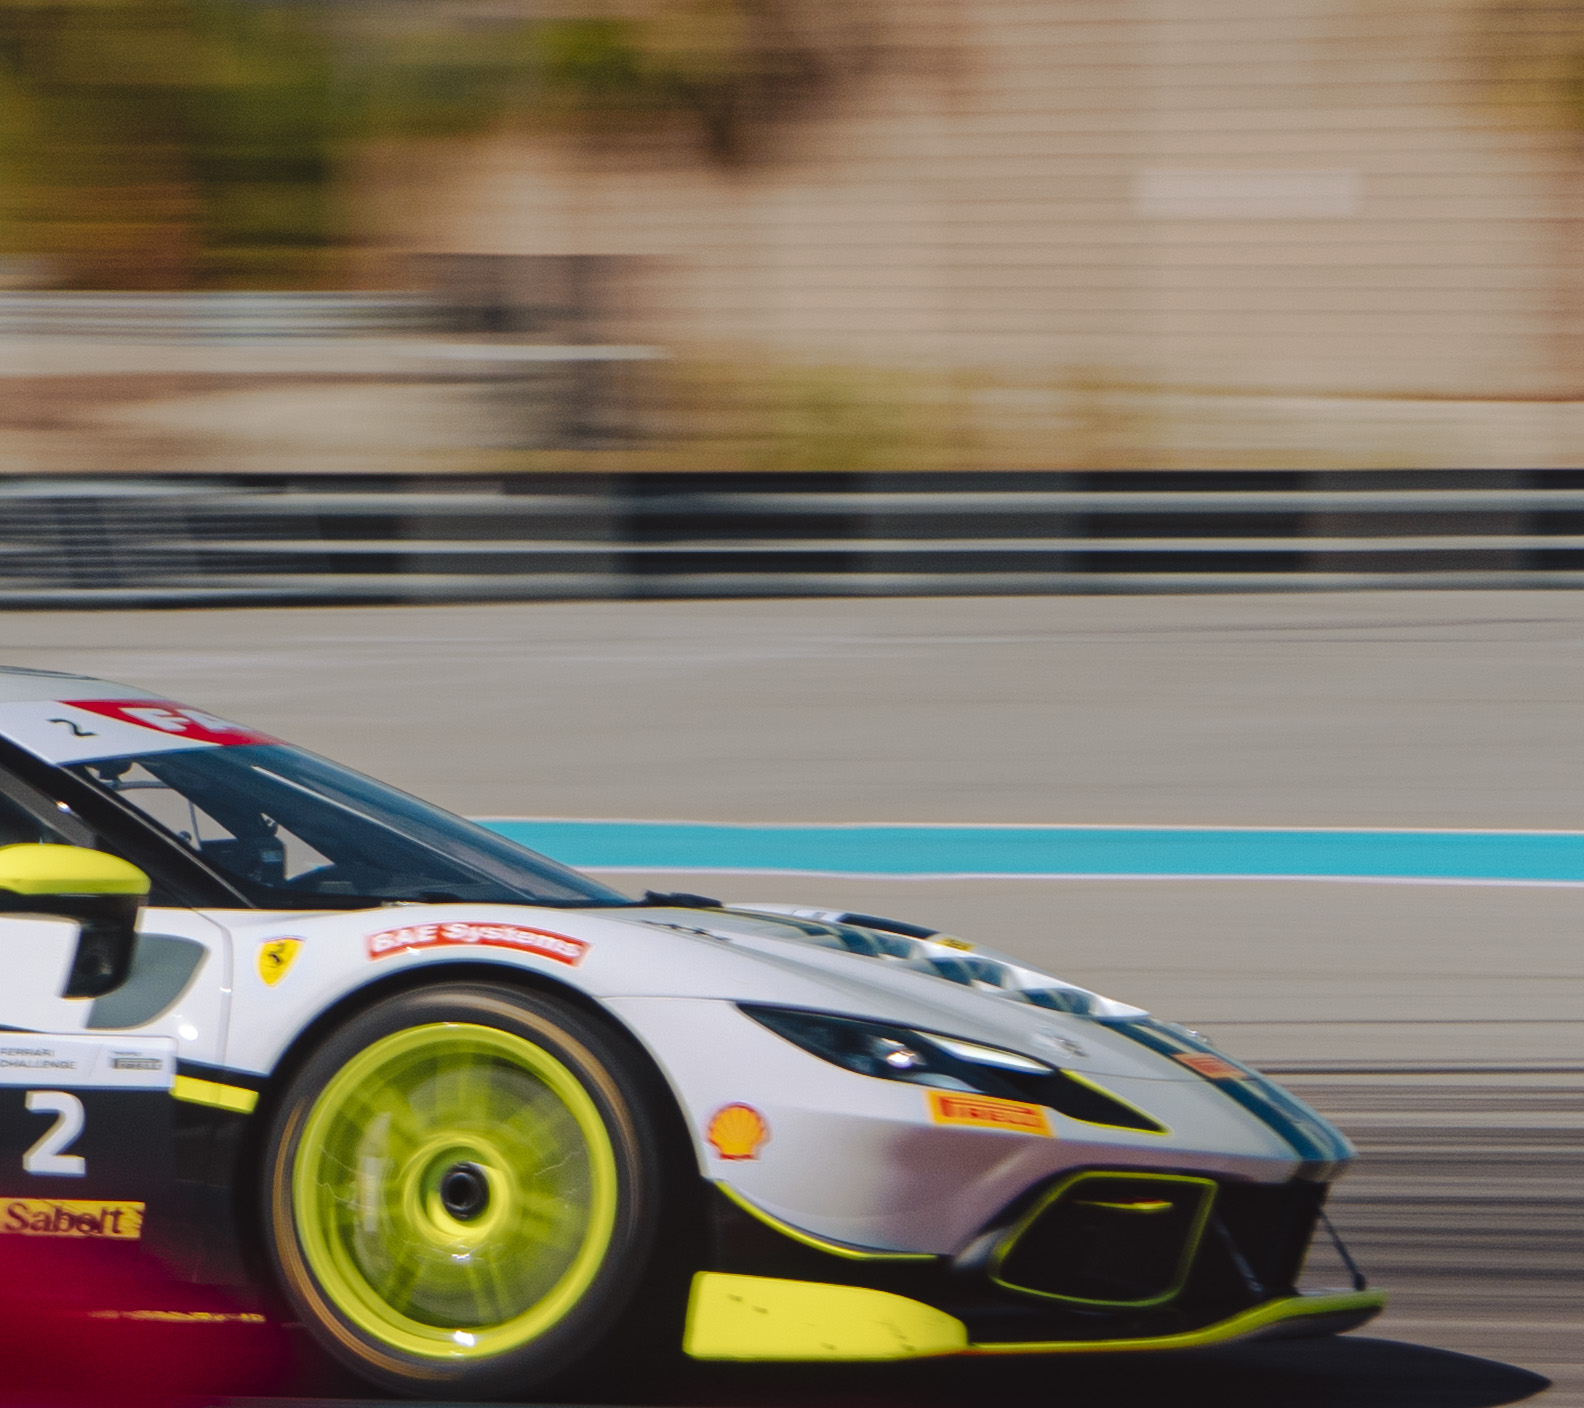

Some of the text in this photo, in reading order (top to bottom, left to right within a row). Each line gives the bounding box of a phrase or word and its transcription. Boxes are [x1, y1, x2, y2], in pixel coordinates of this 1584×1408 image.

[373, 923, 580, 958] BAE Systems
[23, 1091, 86, 1176] 2
[4, 1202, 124, 1234] Sabelt
